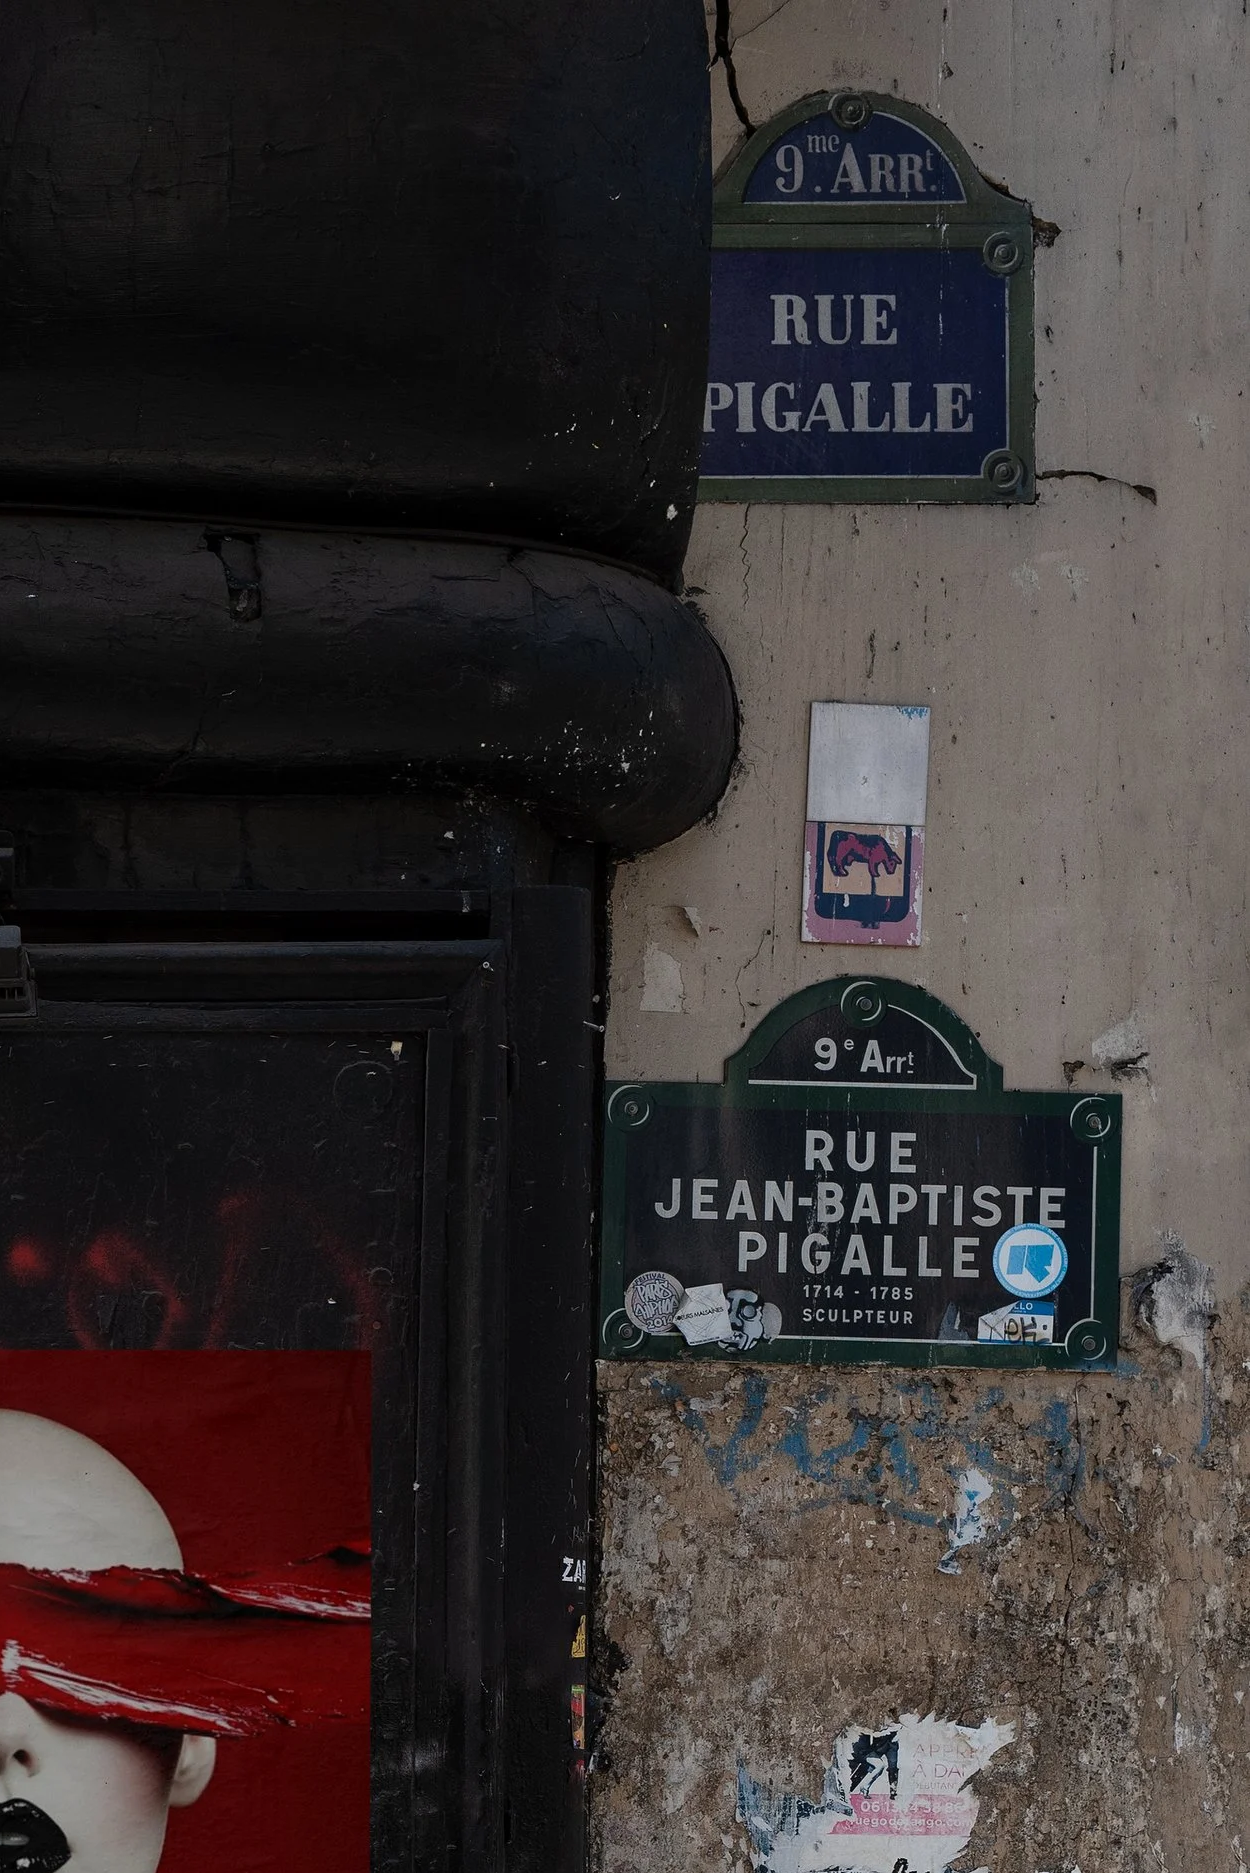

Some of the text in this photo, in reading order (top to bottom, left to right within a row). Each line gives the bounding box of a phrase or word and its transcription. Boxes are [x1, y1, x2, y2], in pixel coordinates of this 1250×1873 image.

[769, 293, 899, 346] RUE
[702, 380, 975, 434] PIGALLE
[804, 1129, 918, 1174] RUE
[654, 1177, 1067, 1229] JEAN-BAPTISTE
[737, 1230, 981, 1279] PIGALLE
[802, 1283, 845, 1300] 1714
[869, 1284, 915, 1301] 1785
[801, 1308, 915, 1326] SCULPTEUR
